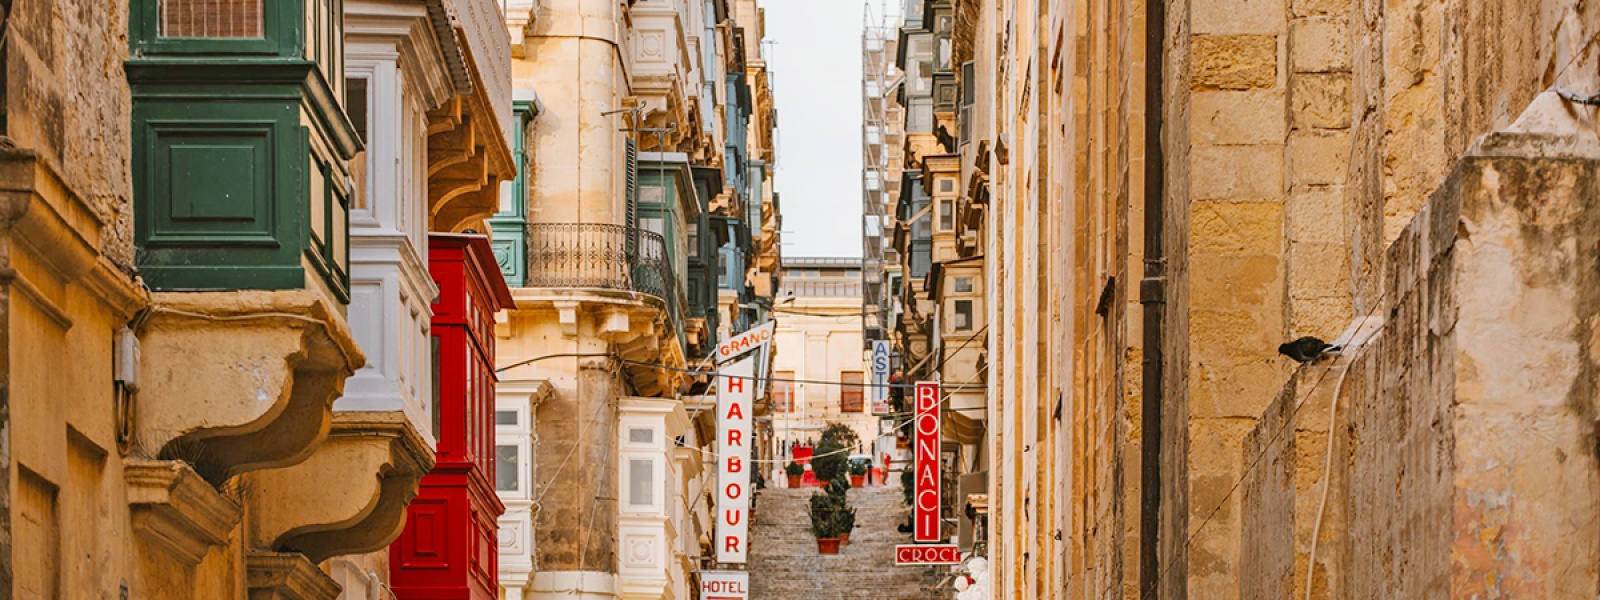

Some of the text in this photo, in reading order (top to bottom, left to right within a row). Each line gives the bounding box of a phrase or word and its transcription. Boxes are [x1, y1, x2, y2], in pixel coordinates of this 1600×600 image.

[720, 329, 769, 356] GRAND
[725, 376, 743, 552] HARBOUR
[918, 386, 938, 537] BONACI
[702, 580, 746, 593] HOTEL
